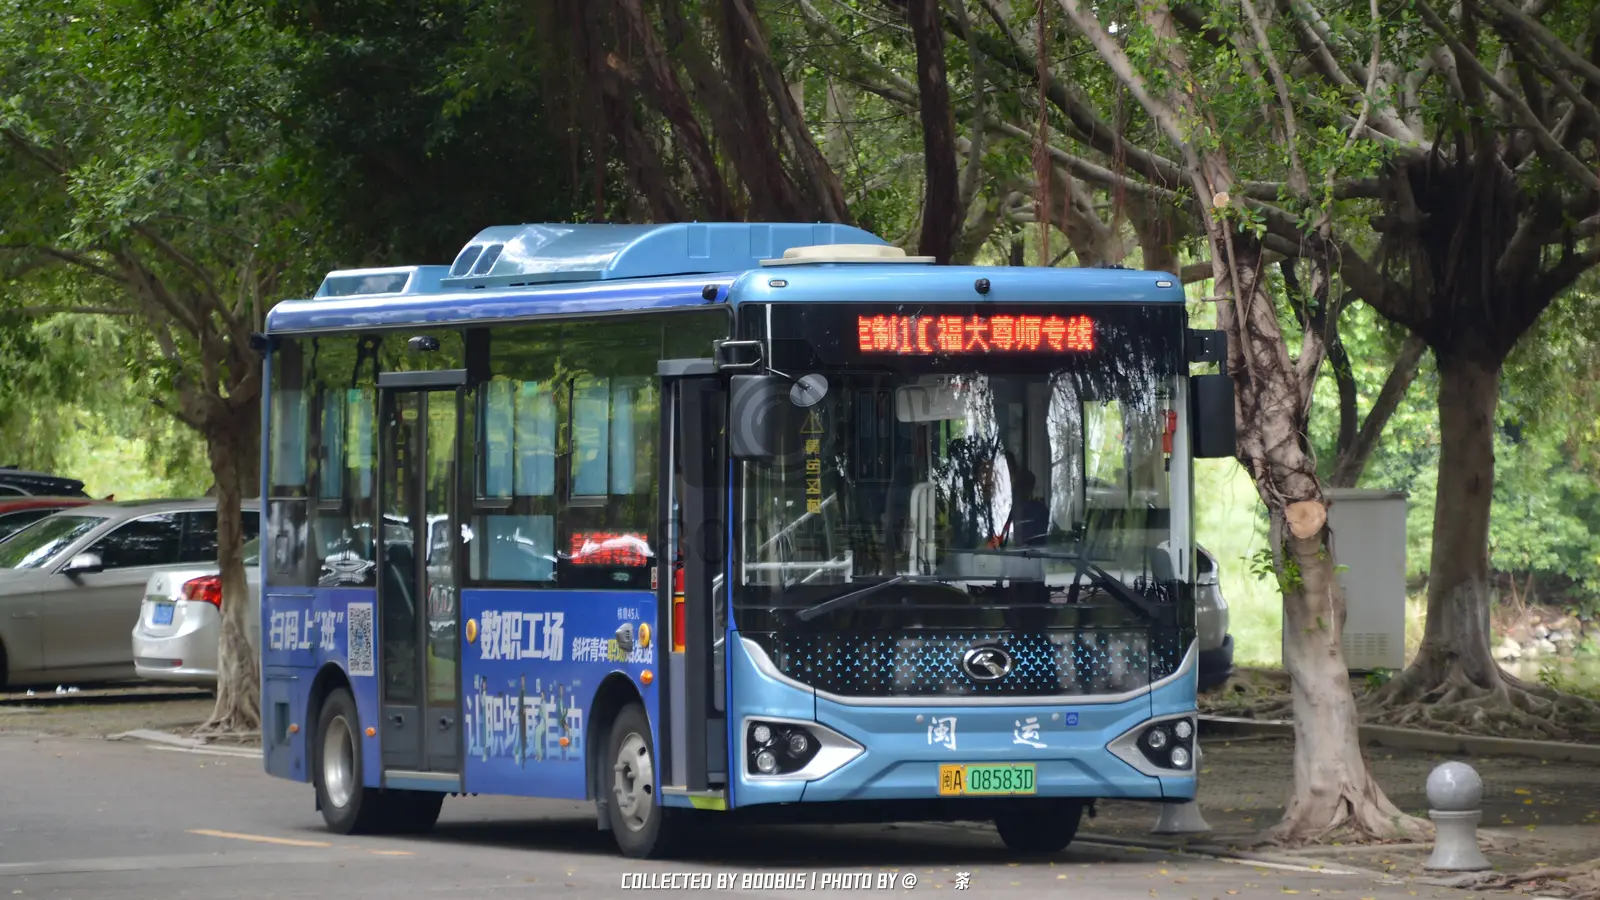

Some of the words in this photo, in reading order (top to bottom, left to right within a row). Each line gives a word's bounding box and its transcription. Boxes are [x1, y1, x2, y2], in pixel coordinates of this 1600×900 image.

[480, 610, 564, 661] 数职工场
[927, 716, 1048, 751] 闽运
